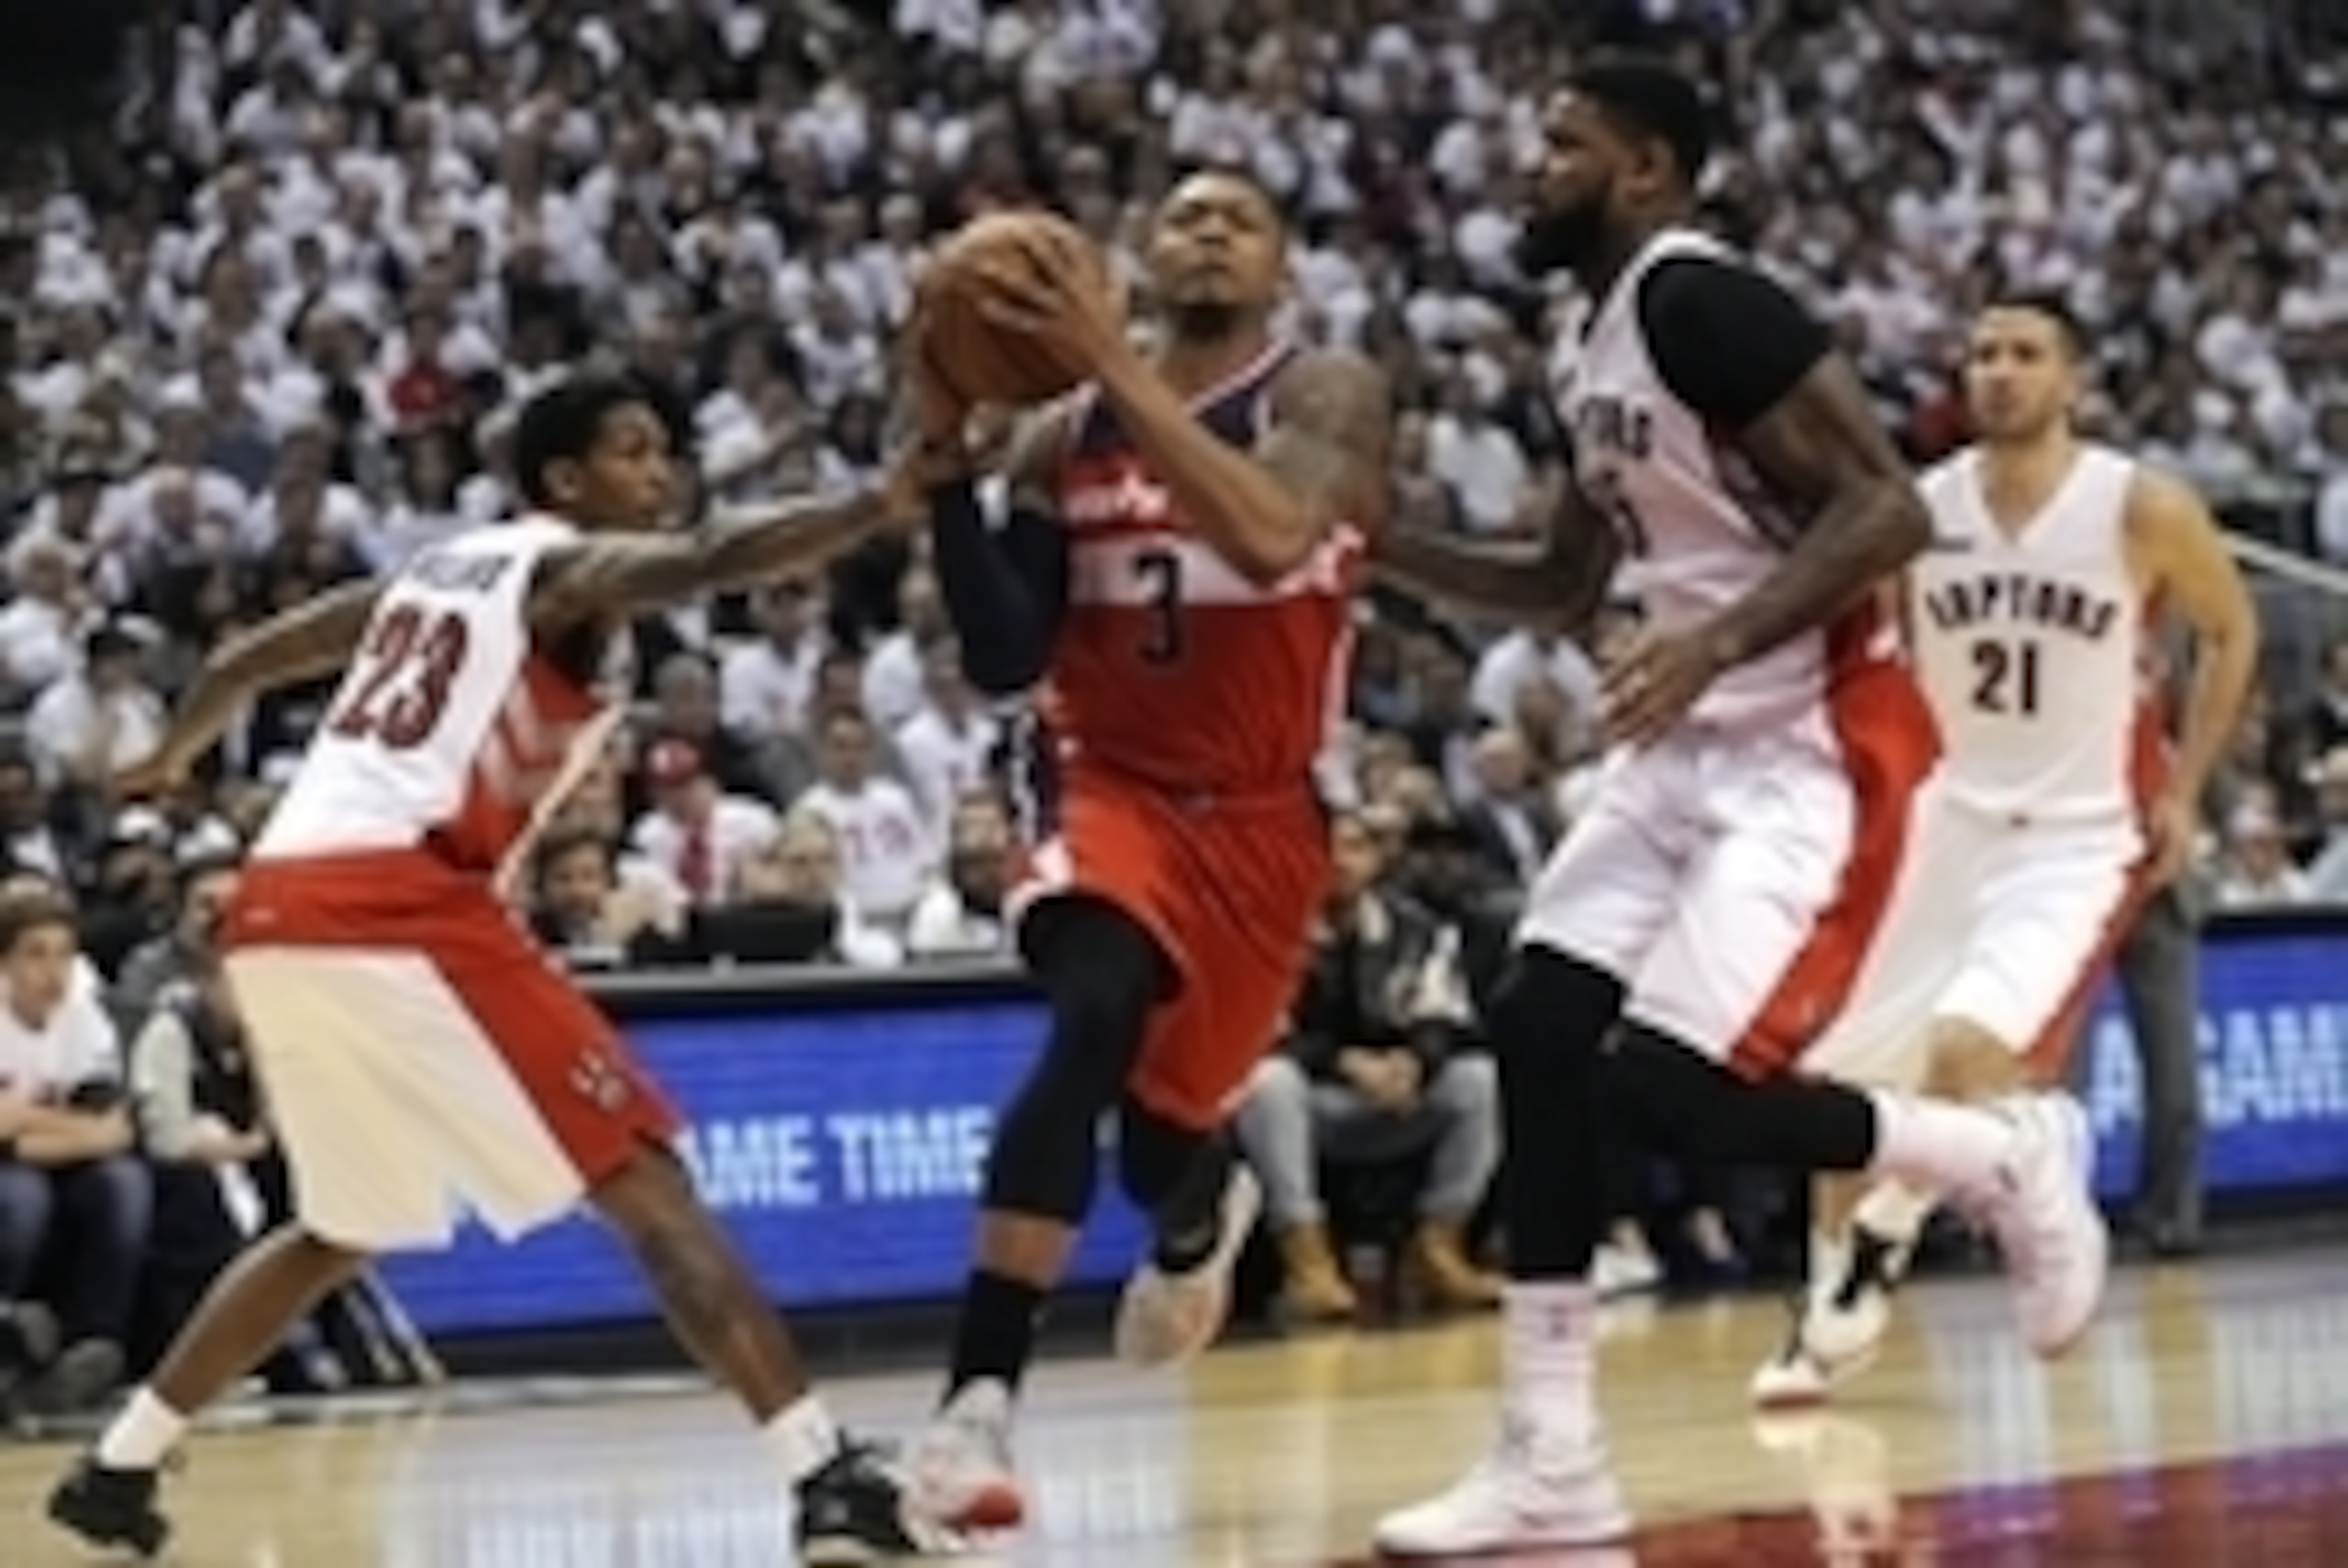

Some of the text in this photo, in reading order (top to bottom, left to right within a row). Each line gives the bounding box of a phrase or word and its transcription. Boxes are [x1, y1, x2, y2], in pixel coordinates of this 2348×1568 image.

[1132, 550, 1183, 668] 3
[328, 602, 470, 750] 23
[1970, 636, 2038, 715] 21
[2196, 1003, 2348, 1126] AM
[673, 1104, 996, 1207] AME TIME
